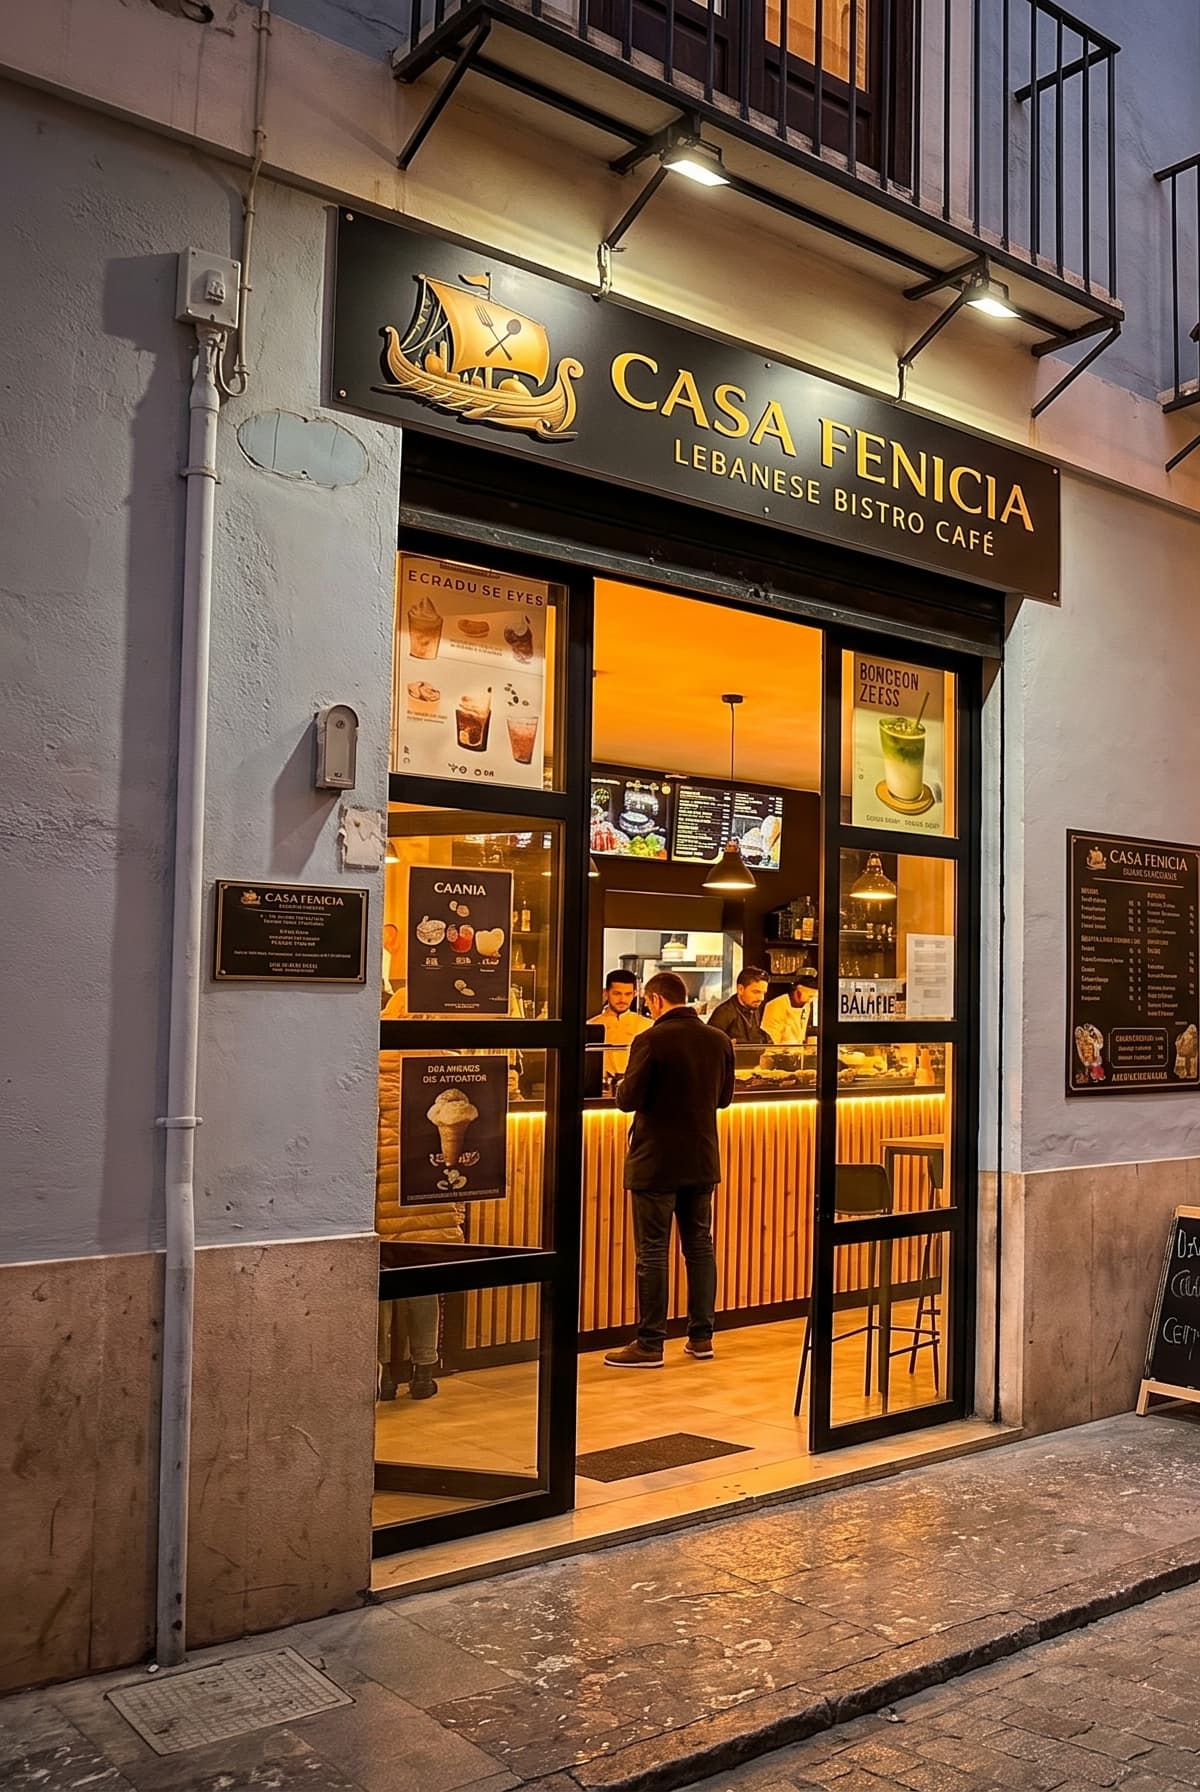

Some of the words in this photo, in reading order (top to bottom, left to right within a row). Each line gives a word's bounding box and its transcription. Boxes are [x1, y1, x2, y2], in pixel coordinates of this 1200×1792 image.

[609, 350, 797, 458] CASA
[818, 416, 1036, 533] FENICIA
[673, 438, 822, 506] LEBANESE
[833, 487, 926, 536] BISTRO
[934, 527, 996, 558] CAFÉ
[481, 585, 501, 598] SE
[507, 589, 544, 606] EYES
[1109, 849, 1142, 866] CASA
[1144, 853, 1188, 872] FENICIA
[264, 892, 299, 904] CASA
[434, 881, 487, 897] CAANIA
